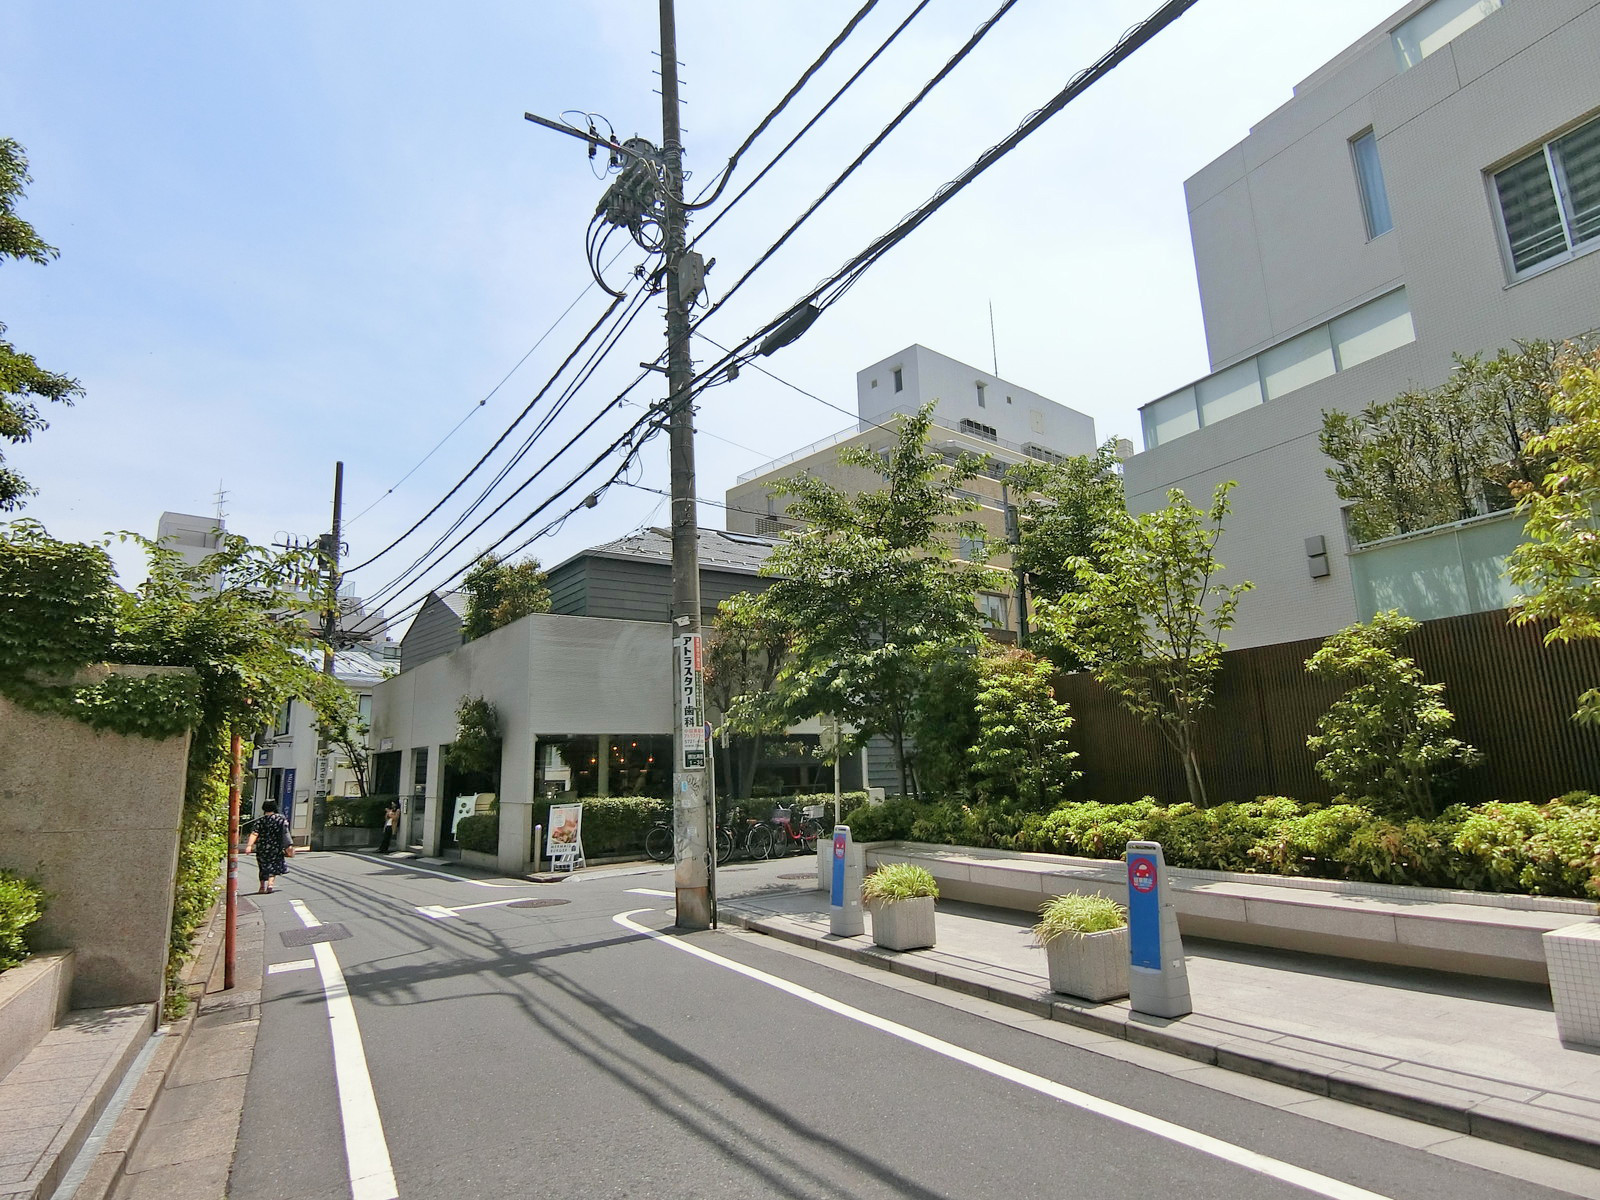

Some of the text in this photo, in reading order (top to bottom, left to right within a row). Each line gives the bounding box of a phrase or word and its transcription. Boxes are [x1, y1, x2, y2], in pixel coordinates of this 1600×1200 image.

[683, 637, 695, 727] アトラスタワー歯科
